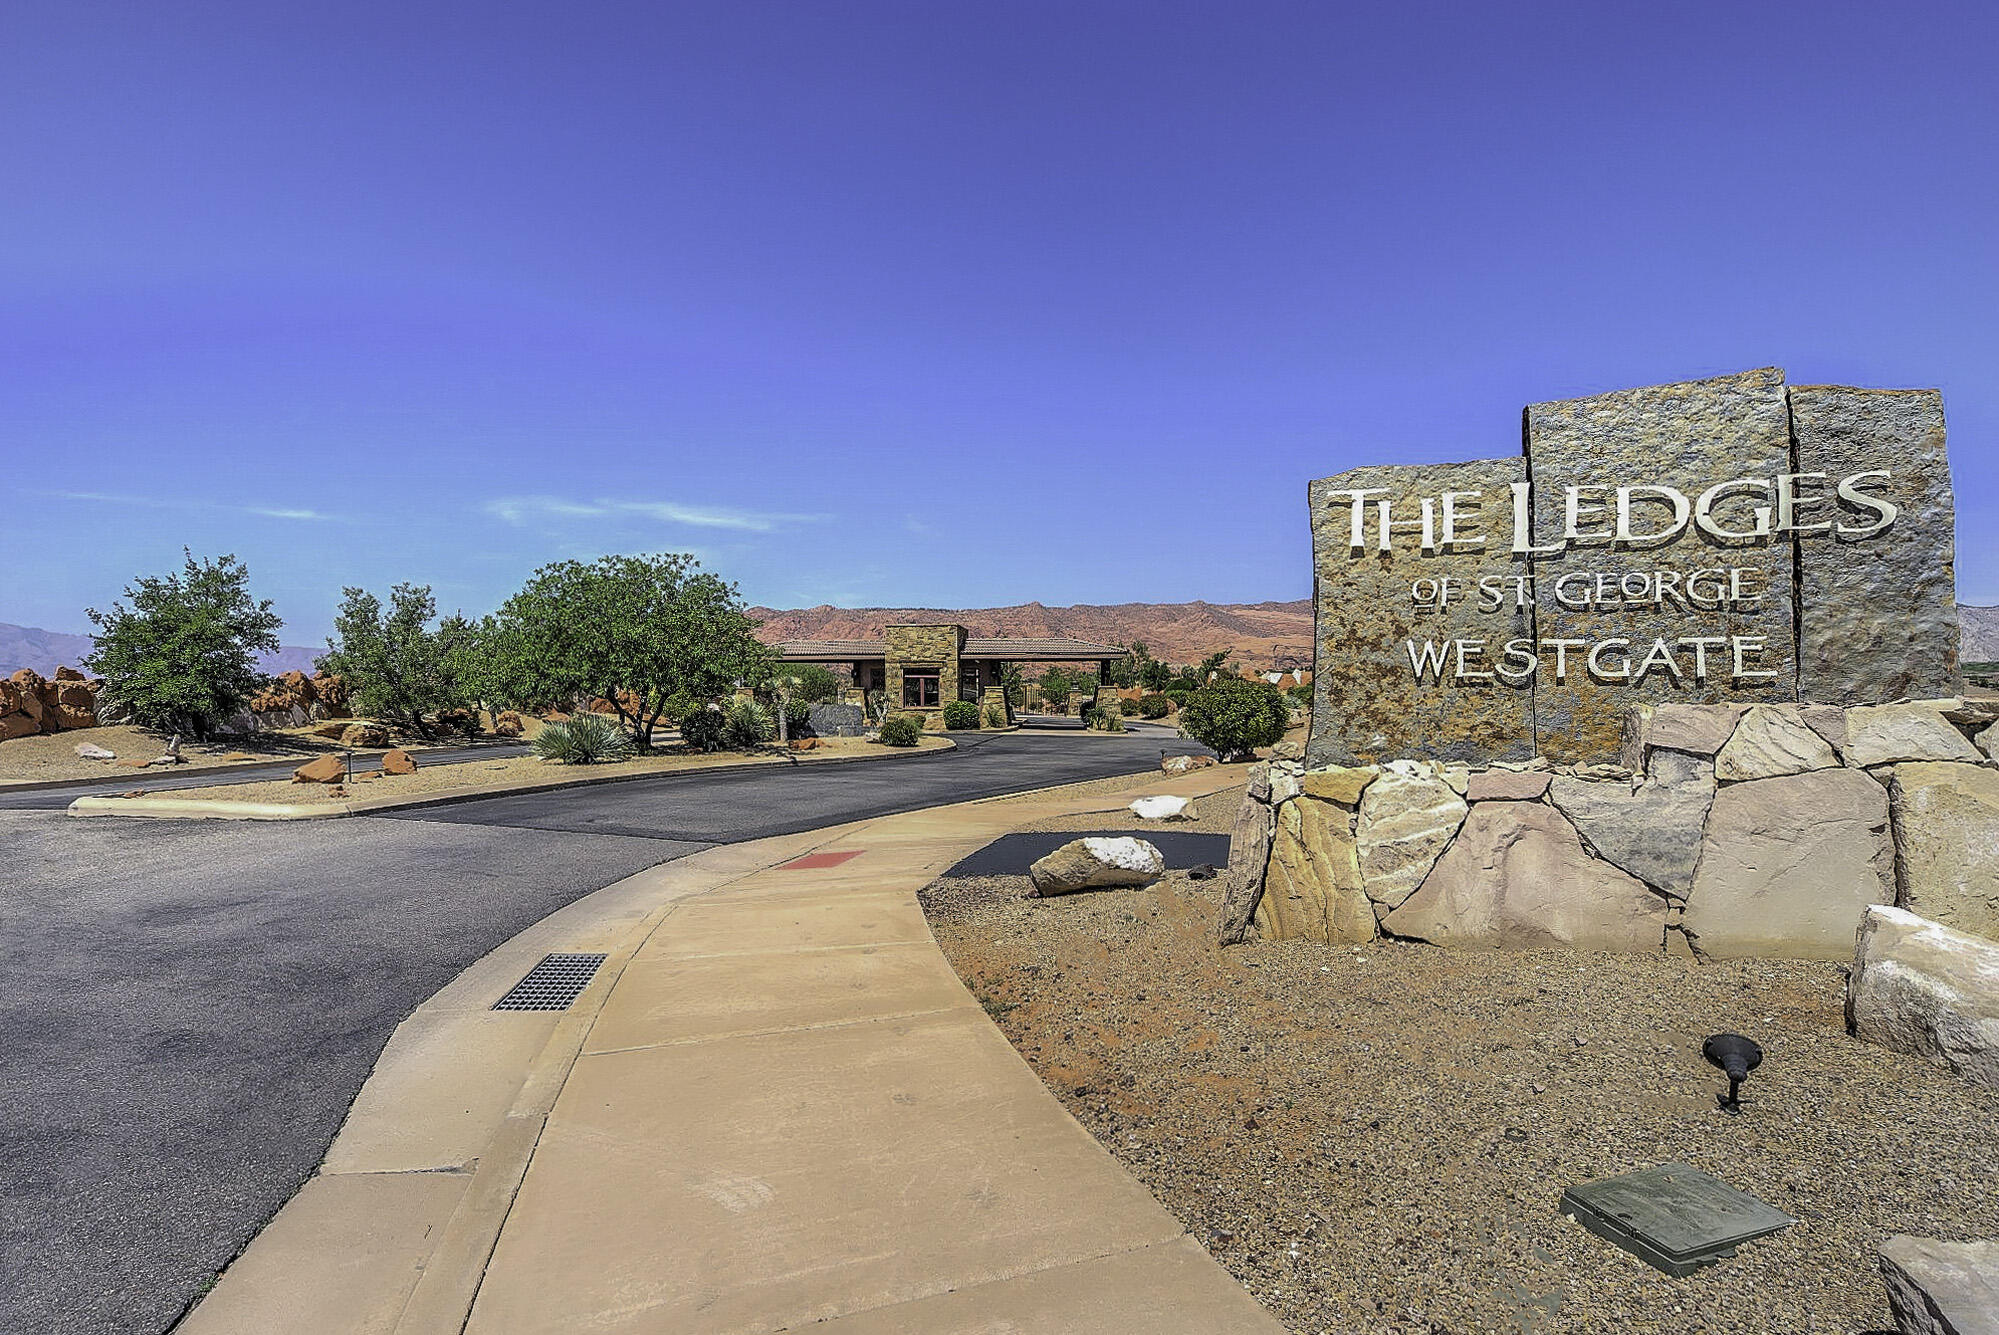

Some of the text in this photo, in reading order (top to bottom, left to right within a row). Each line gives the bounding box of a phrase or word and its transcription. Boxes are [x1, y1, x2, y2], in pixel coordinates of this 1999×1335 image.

[1327, 469, 1899, 553] THE LEDGES
[1411, 577, 1462, 608] OF
[1554, 567, 1762, 605] GEORGE
[1406, 635, 1779, 678] WESTGATE
